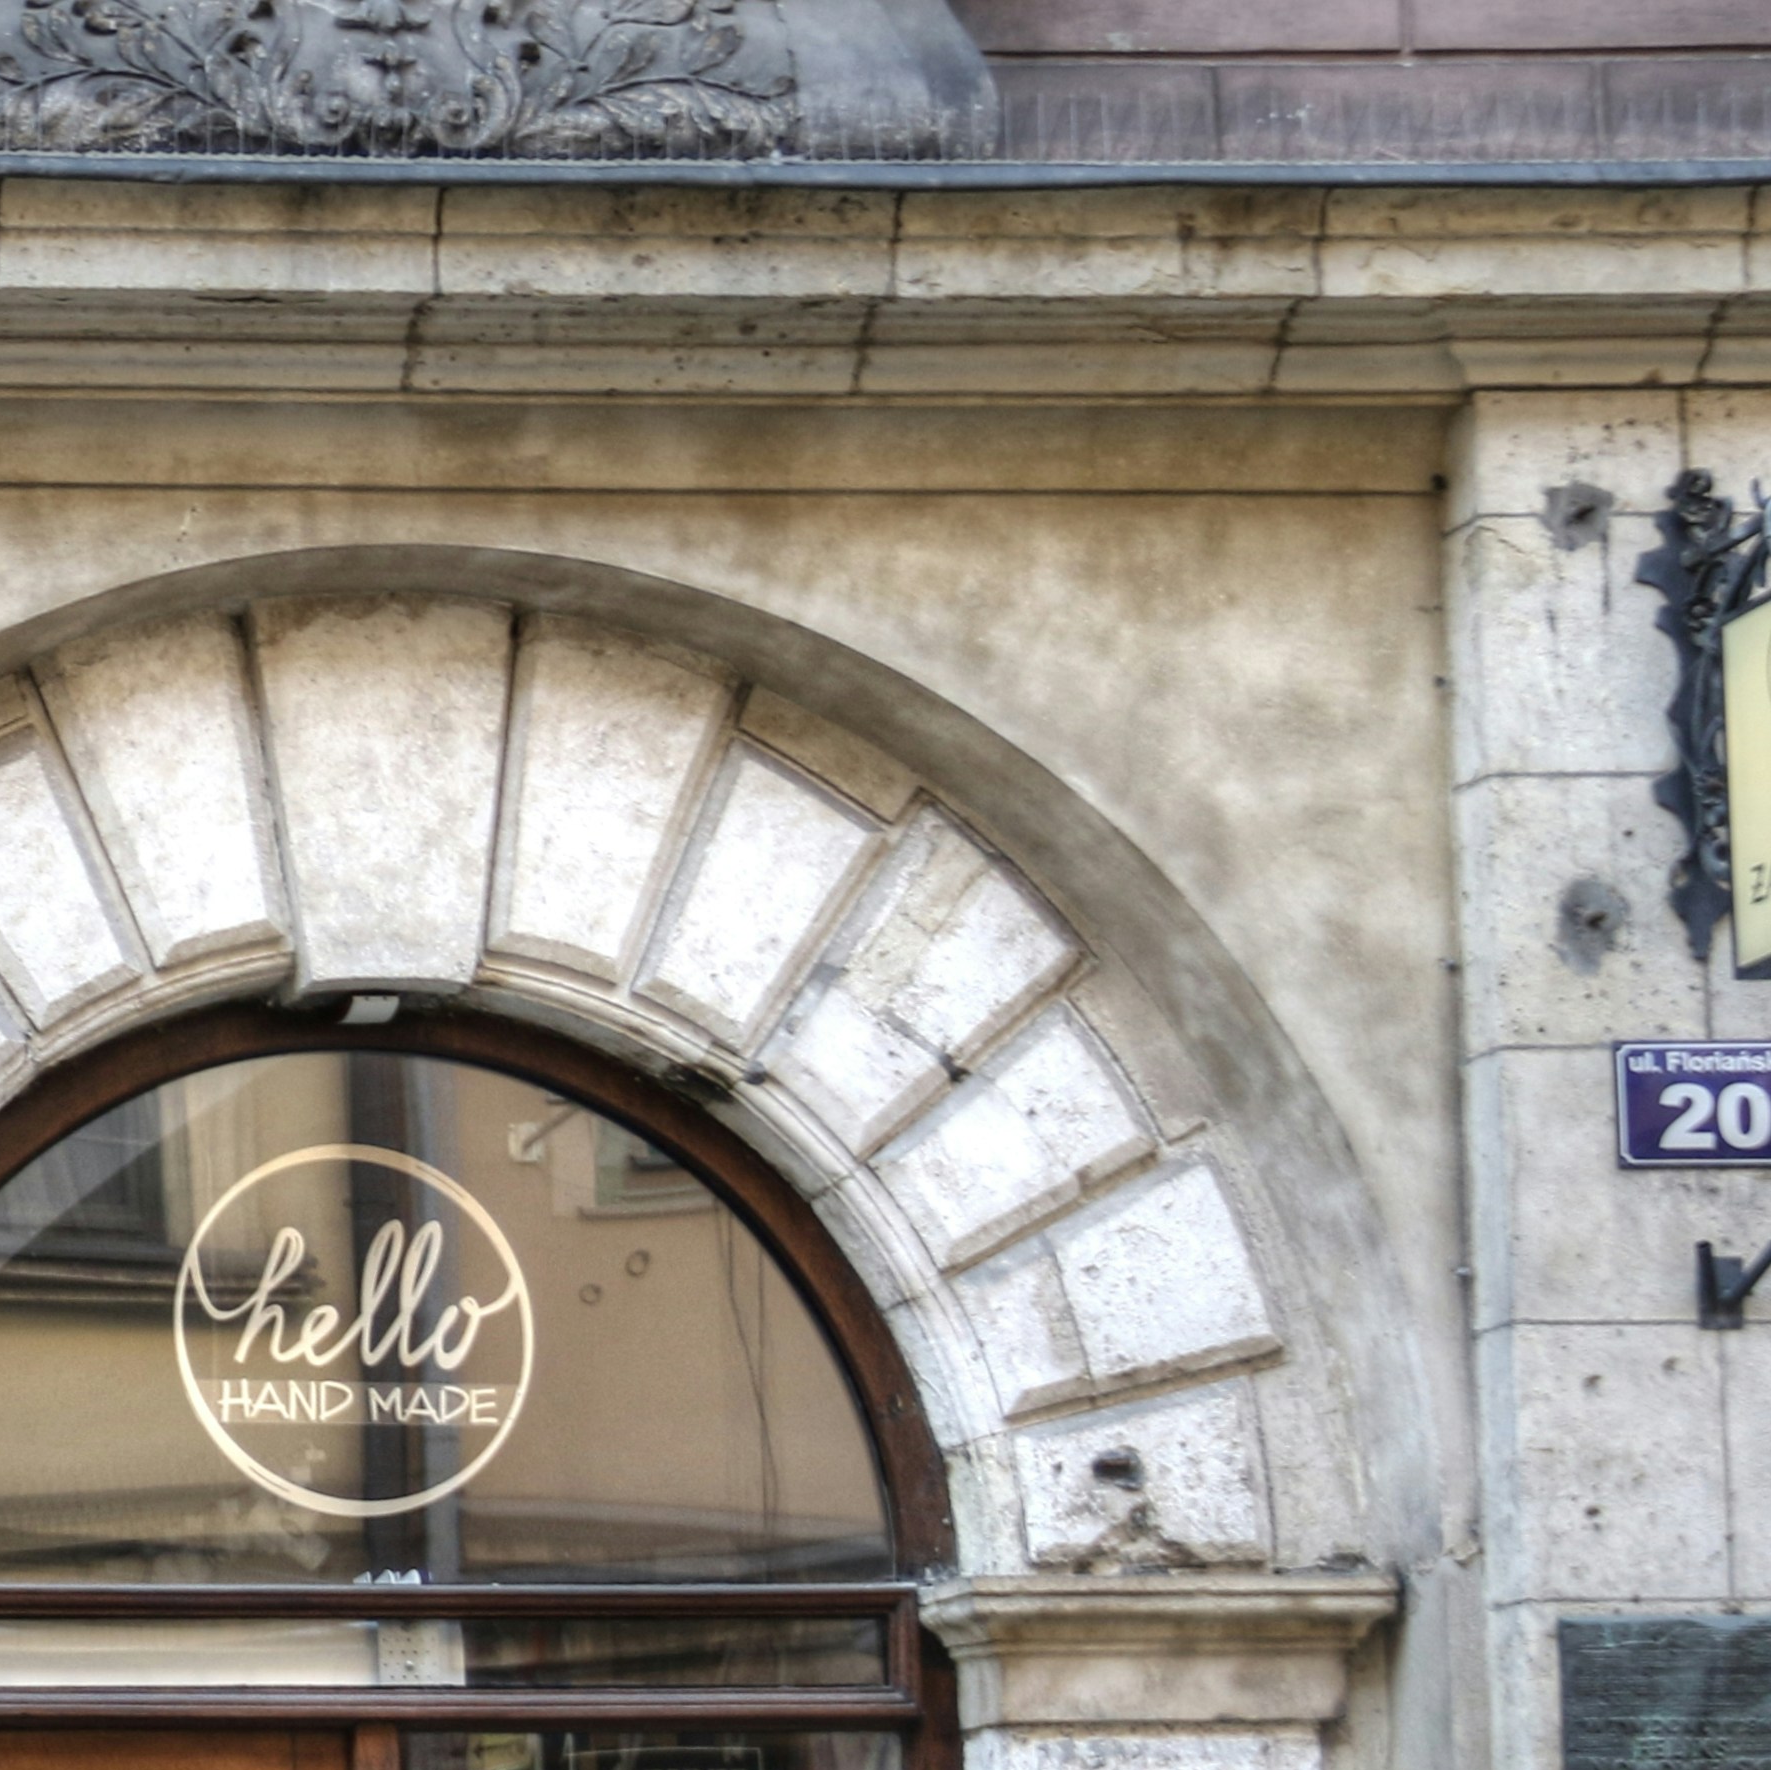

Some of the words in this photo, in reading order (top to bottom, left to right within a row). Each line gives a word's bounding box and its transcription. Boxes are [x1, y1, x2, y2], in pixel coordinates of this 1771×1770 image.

[1628, 1051, 1662, 1073] ul.
[1658, 1082, 1771, 1150] 20
[192, 1219, 518, 1369] hello
[218, 1380, 354, 1423] HAND
[368, 1385, 500, 1424] MADE
